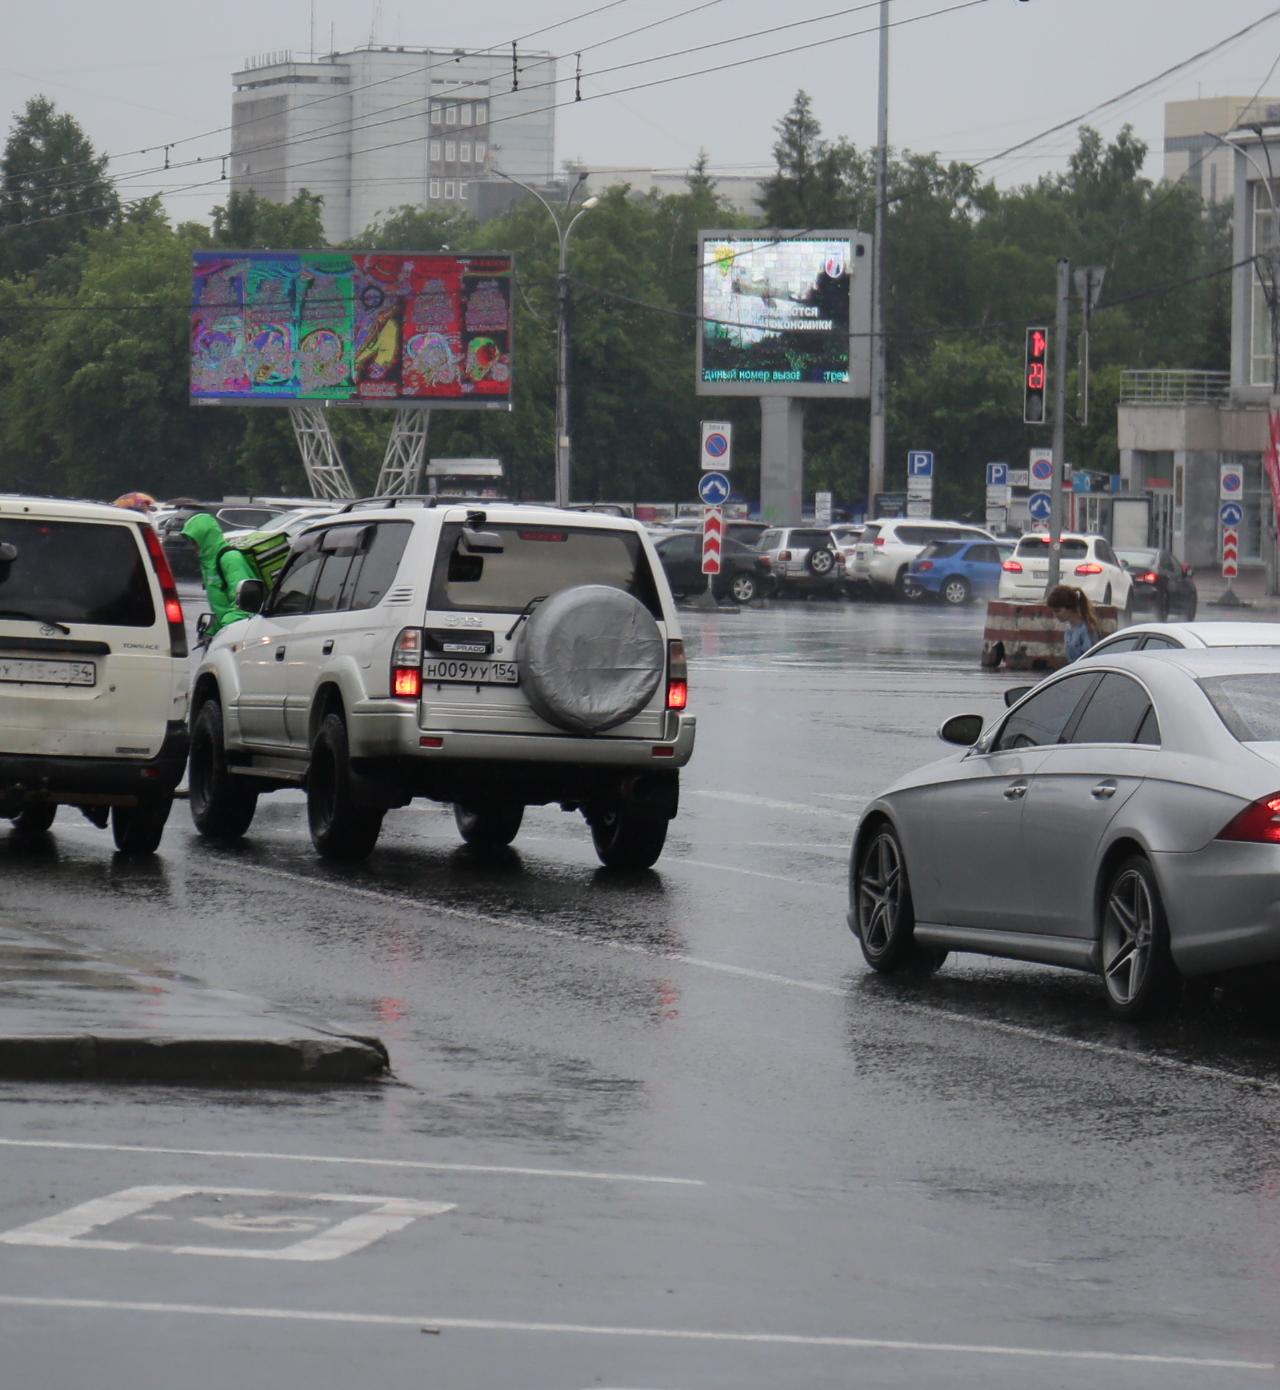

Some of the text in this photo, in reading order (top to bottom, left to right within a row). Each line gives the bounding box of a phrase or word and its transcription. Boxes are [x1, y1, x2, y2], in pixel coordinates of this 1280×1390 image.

[703, 368, 737, 381] диный
[739, 371, 770, 382] номер
[914, 454, 928, 474] P
[991, 465, 1004, 483] P
[491, 663, 516, 676] 154
